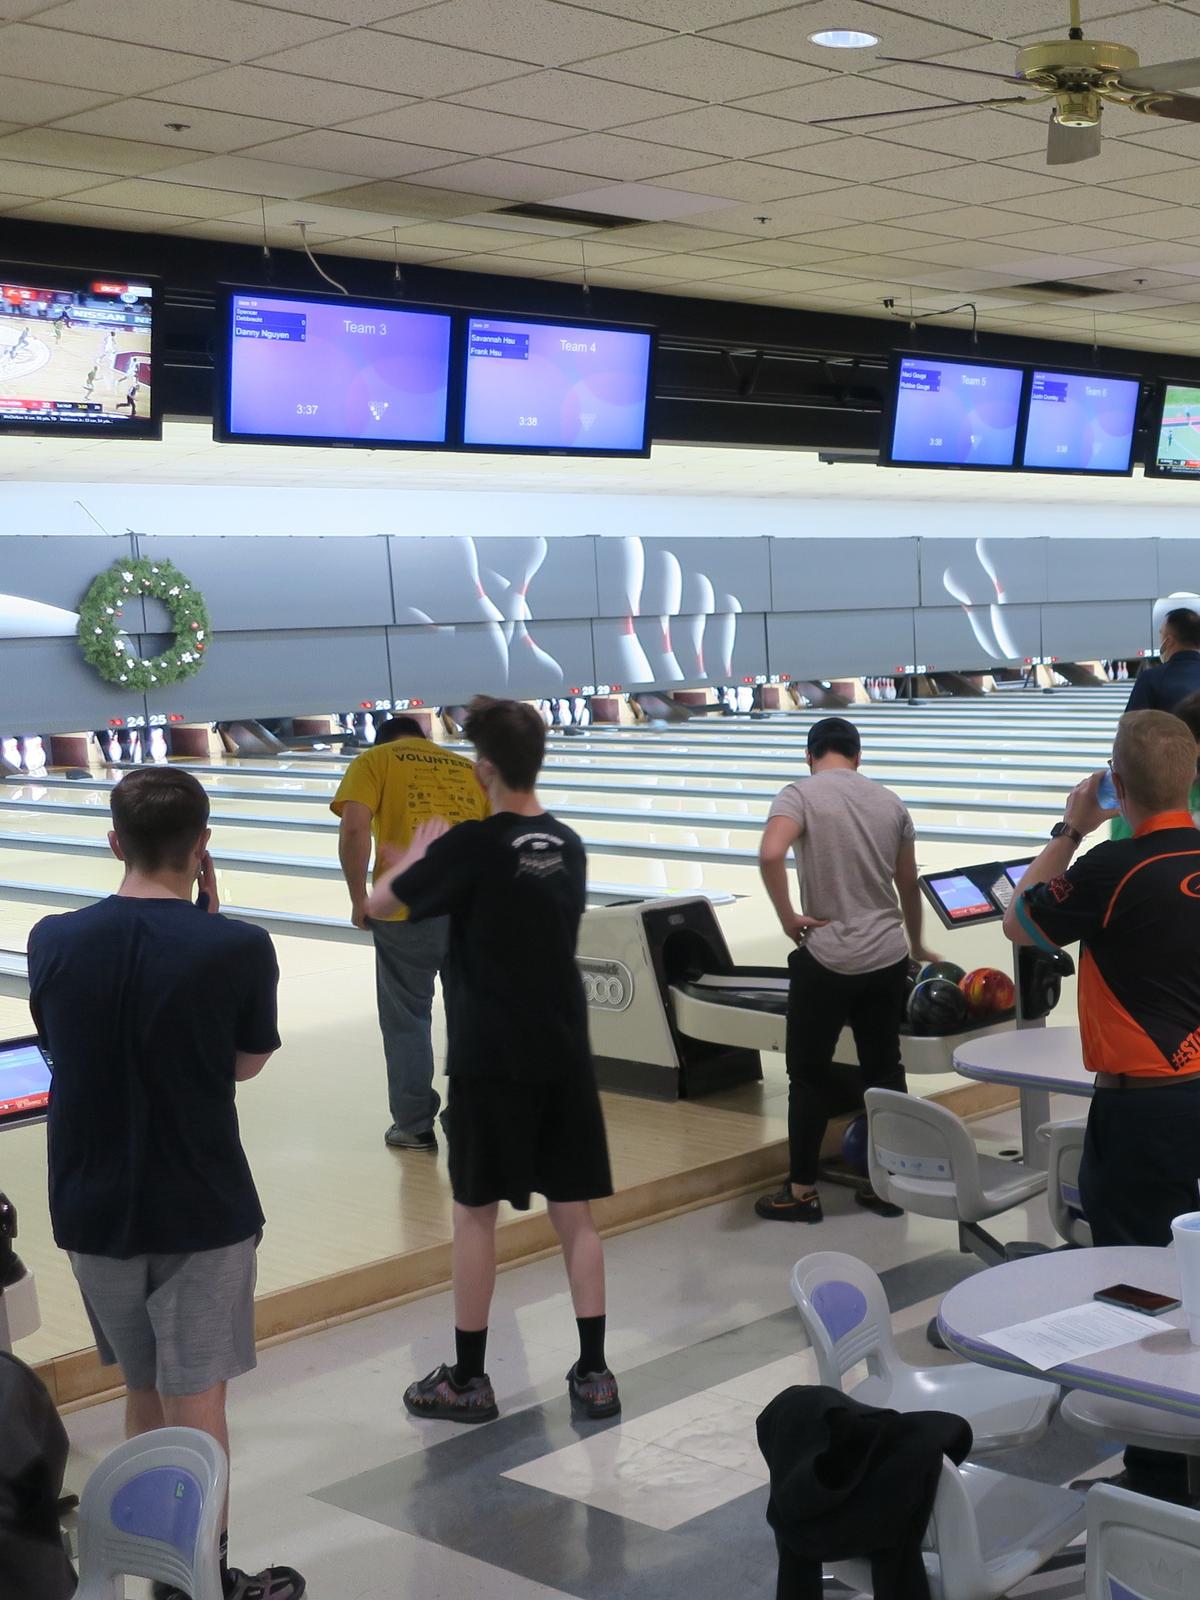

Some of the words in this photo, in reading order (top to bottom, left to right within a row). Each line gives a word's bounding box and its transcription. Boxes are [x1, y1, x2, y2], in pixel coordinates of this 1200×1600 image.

[73, 309, 126, 321] NISSAN
[236, 327, 260, 338] Danny
[261, 329, 290, 340] Nguyen
[344, 320, 376, 335] Team
[379, 323, 388, 336] 3
[471, 334, 502, 344] Savannah
[503, 337, 516, 345] Hsu
[470, 347, 488, 356] Frank
[489, 349, 502, 357] Hsu
[560, 339, 588, 353] Team
[589, 342, 597, 353] 4
[962, 374, 981, 386] Team
[296, 402, 319, 416] 3:37
[519, 416, 538, 426] 3:38
[755, 675, 767, 684] 30
[769, 674, 780, 683] 31
[582, 685, 595, 696] 28
[597, 684, 610, 695] 29
[375, 699, 391, 711] 26
[394, 699, 410, 710] 27
[126, 715, 146, 728] 24
[149, 713, 167, 726] 25
[395, 753, 473, 770] VOLUNTEER
